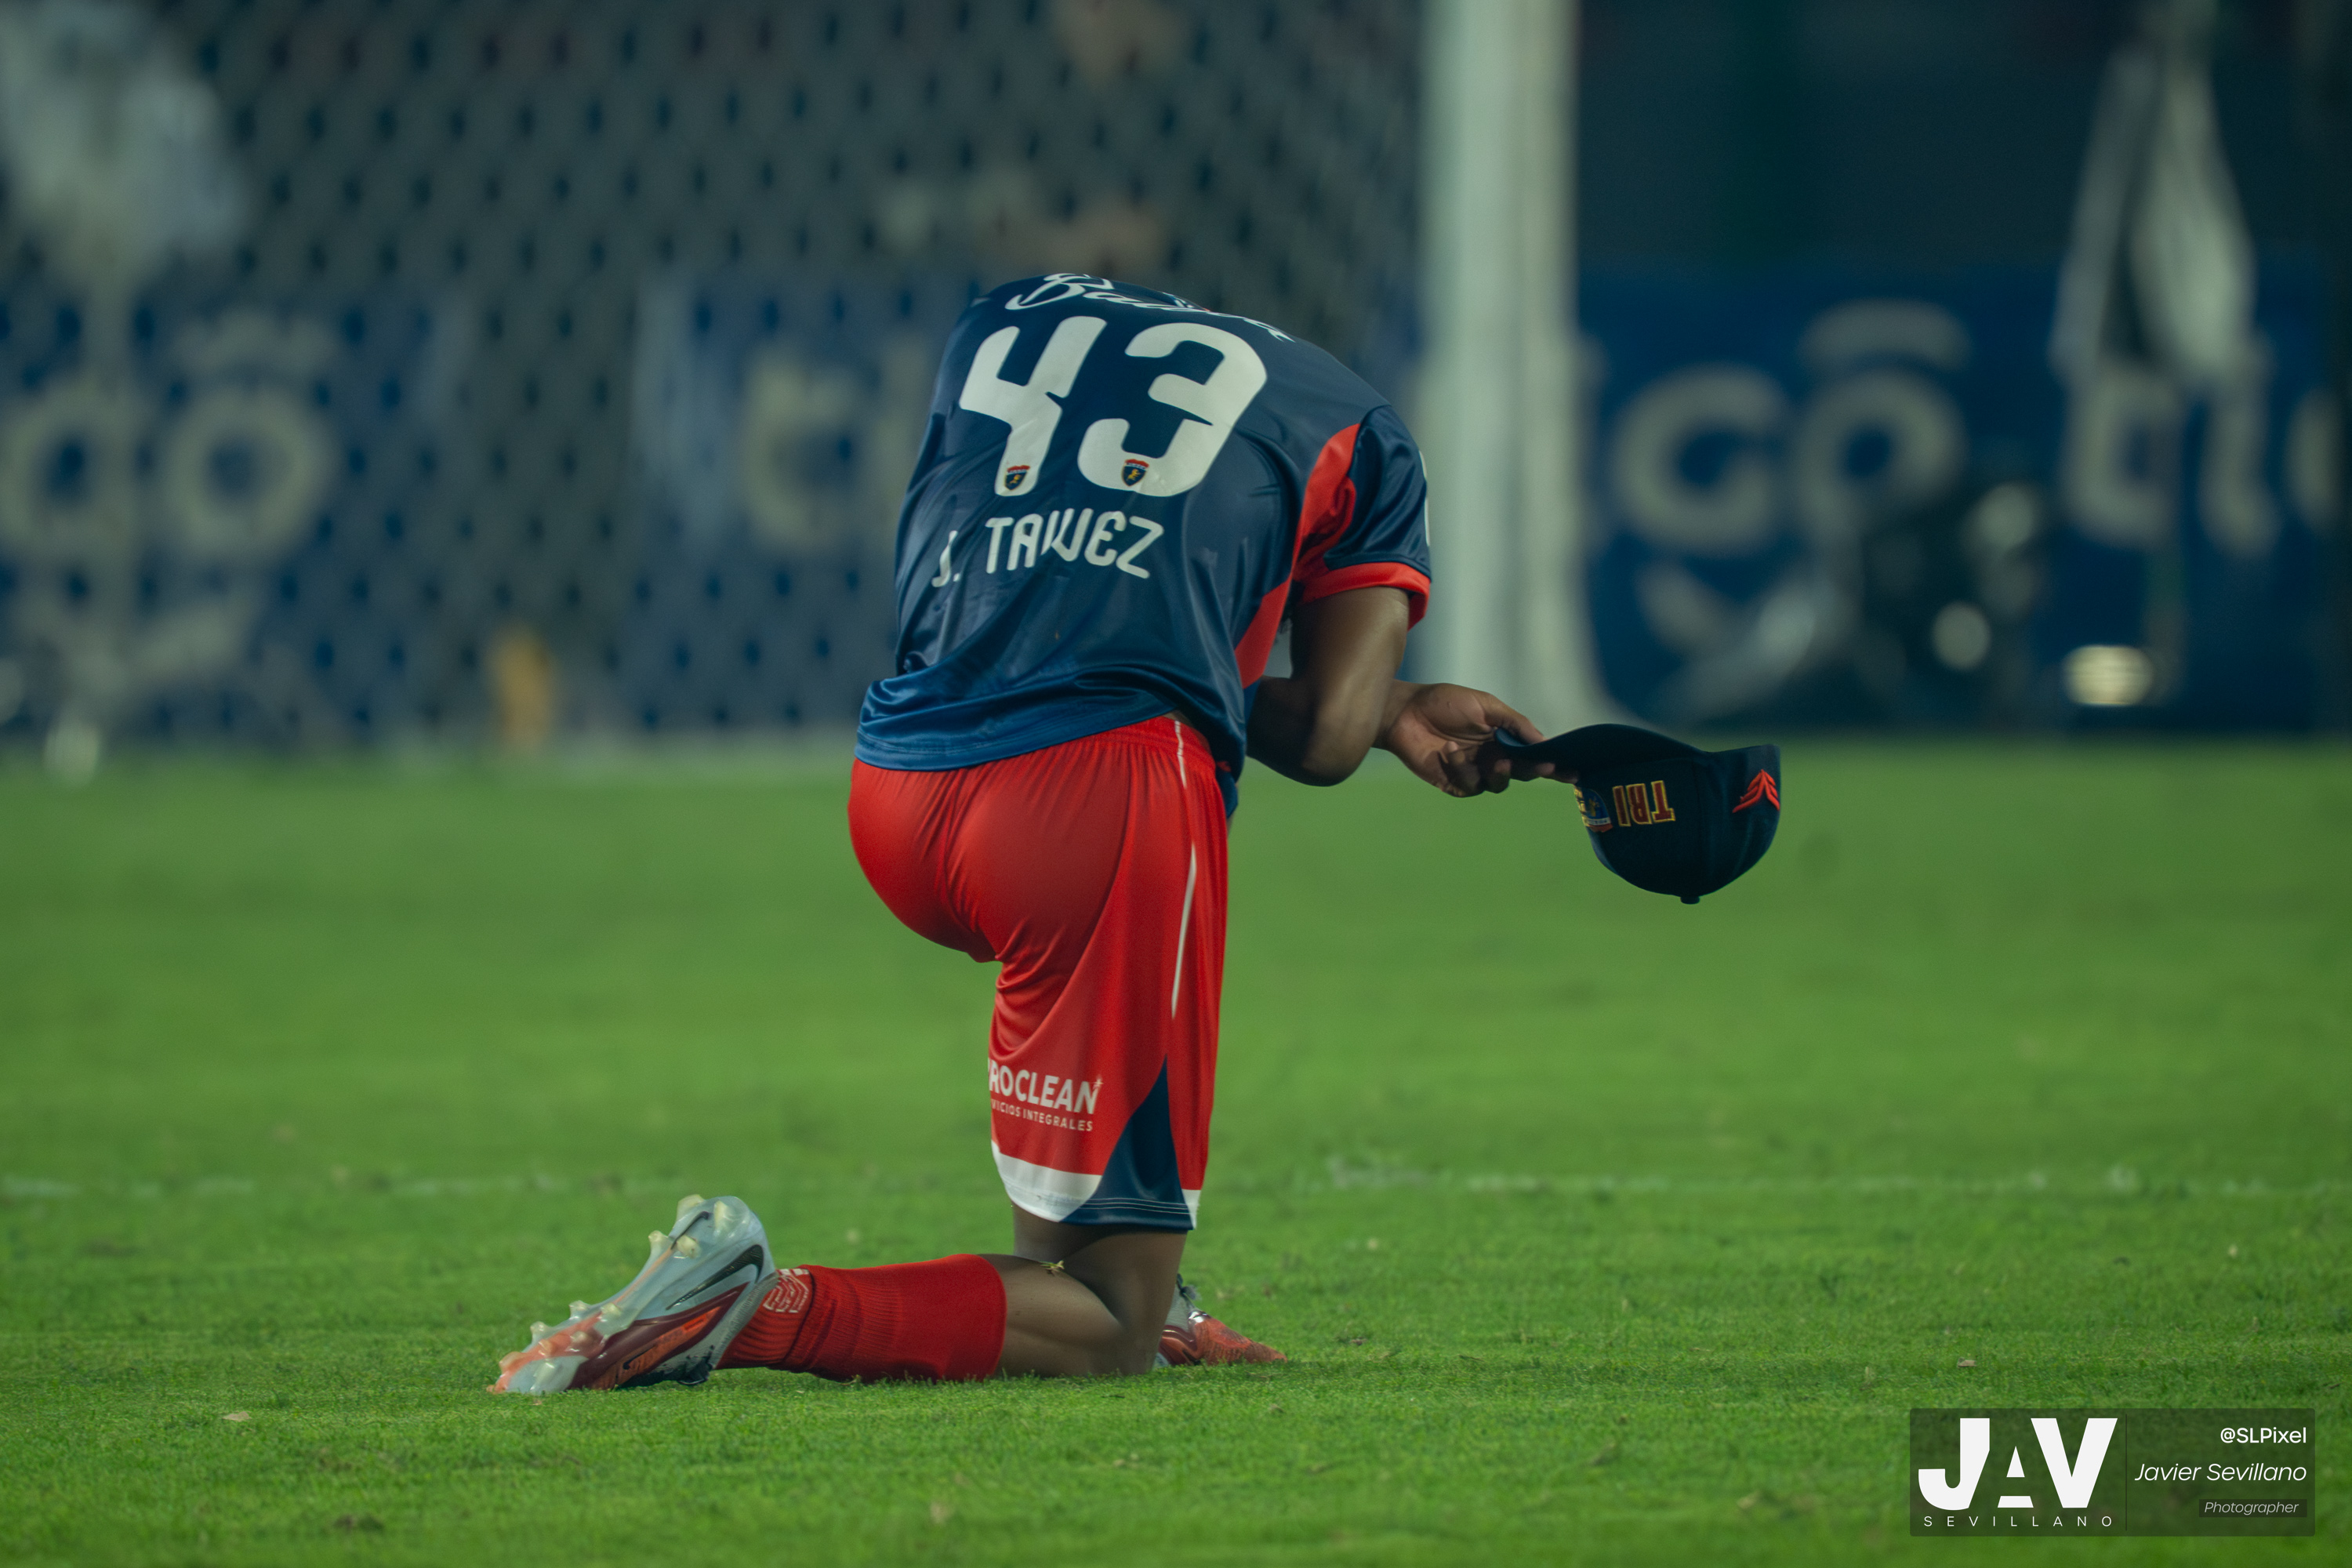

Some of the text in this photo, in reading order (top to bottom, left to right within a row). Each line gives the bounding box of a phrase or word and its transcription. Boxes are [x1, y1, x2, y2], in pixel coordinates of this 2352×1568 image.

[959, 316, 1267, 497] 43
[1613, 780, 1675, 826] TRI
[988, 1058, 1102, 1115] ROCLEAN
[1023, 1109, 1093, 1131] INTEGRALES
